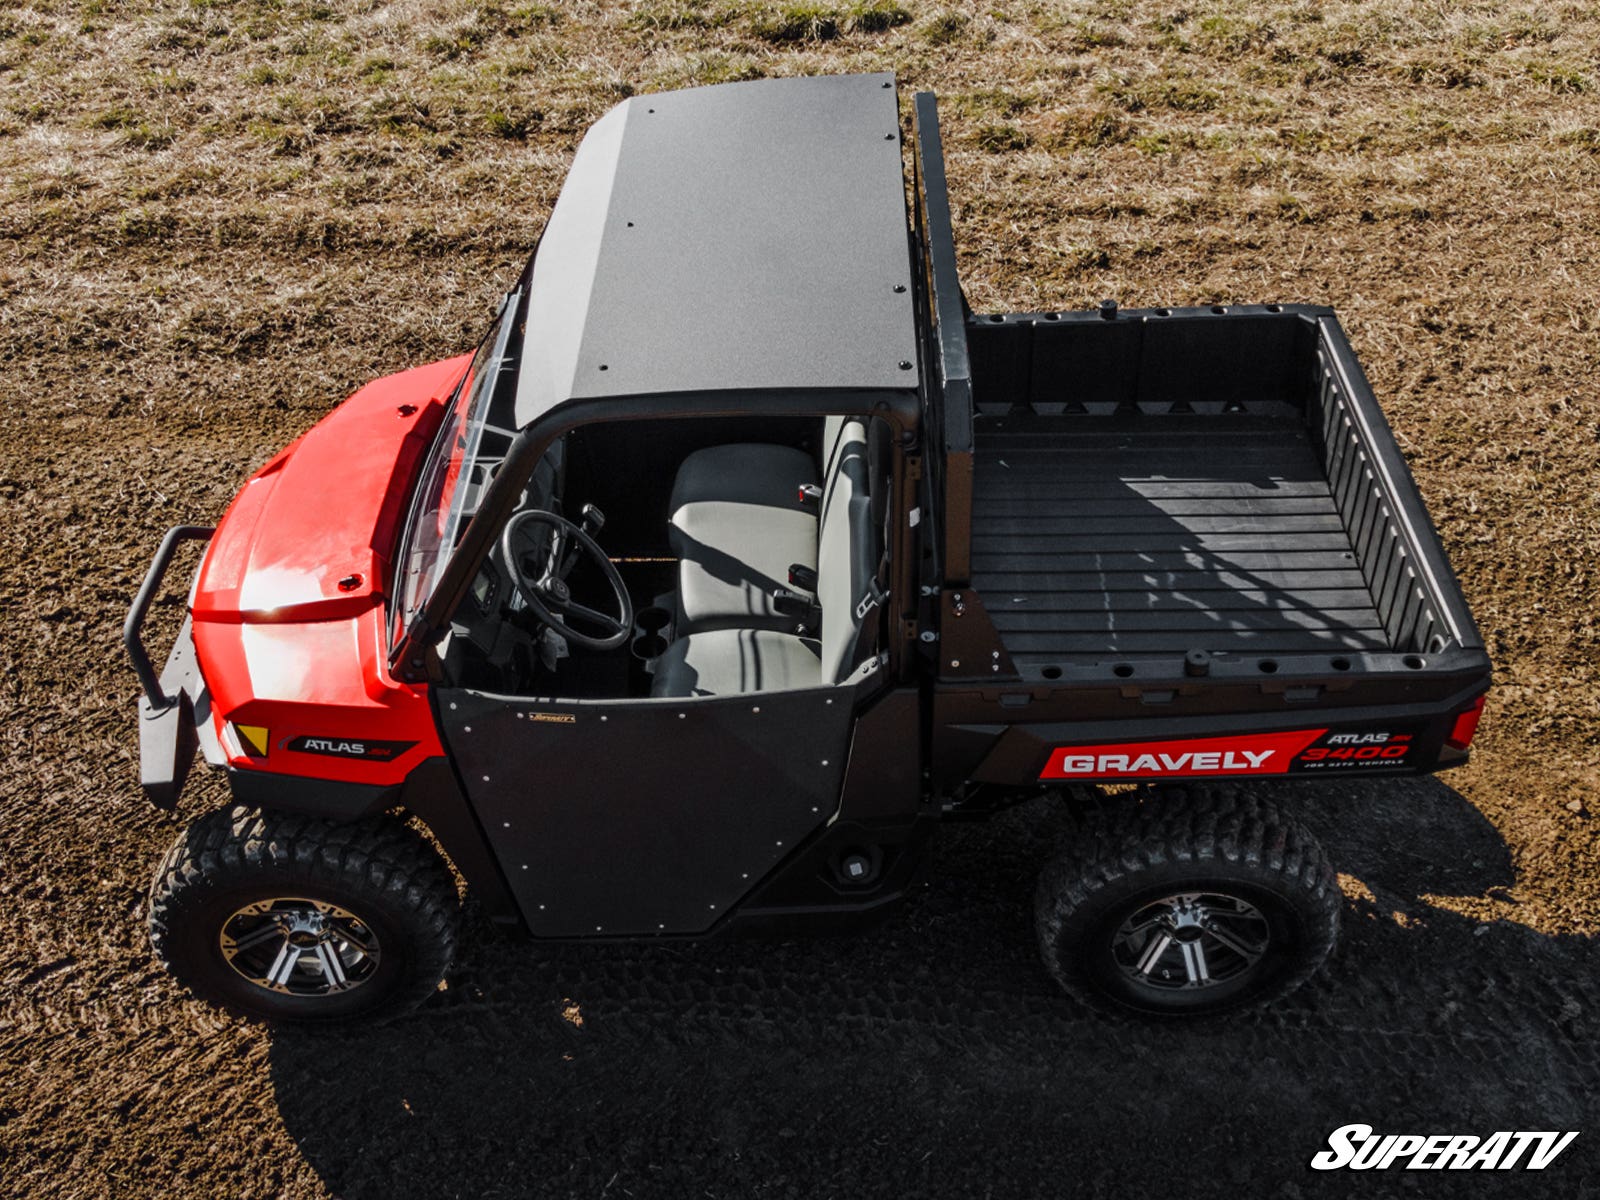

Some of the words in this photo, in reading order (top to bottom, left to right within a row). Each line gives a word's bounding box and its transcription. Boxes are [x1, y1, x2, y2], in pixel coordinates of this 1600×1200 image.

[304, 739, 365, 754] ATLAS
[1327, 733, 1390, 745] ATLAS
[1300, 745, 1410, 761] 3400
[1063, 750, 1276, 773] GRAVELY
